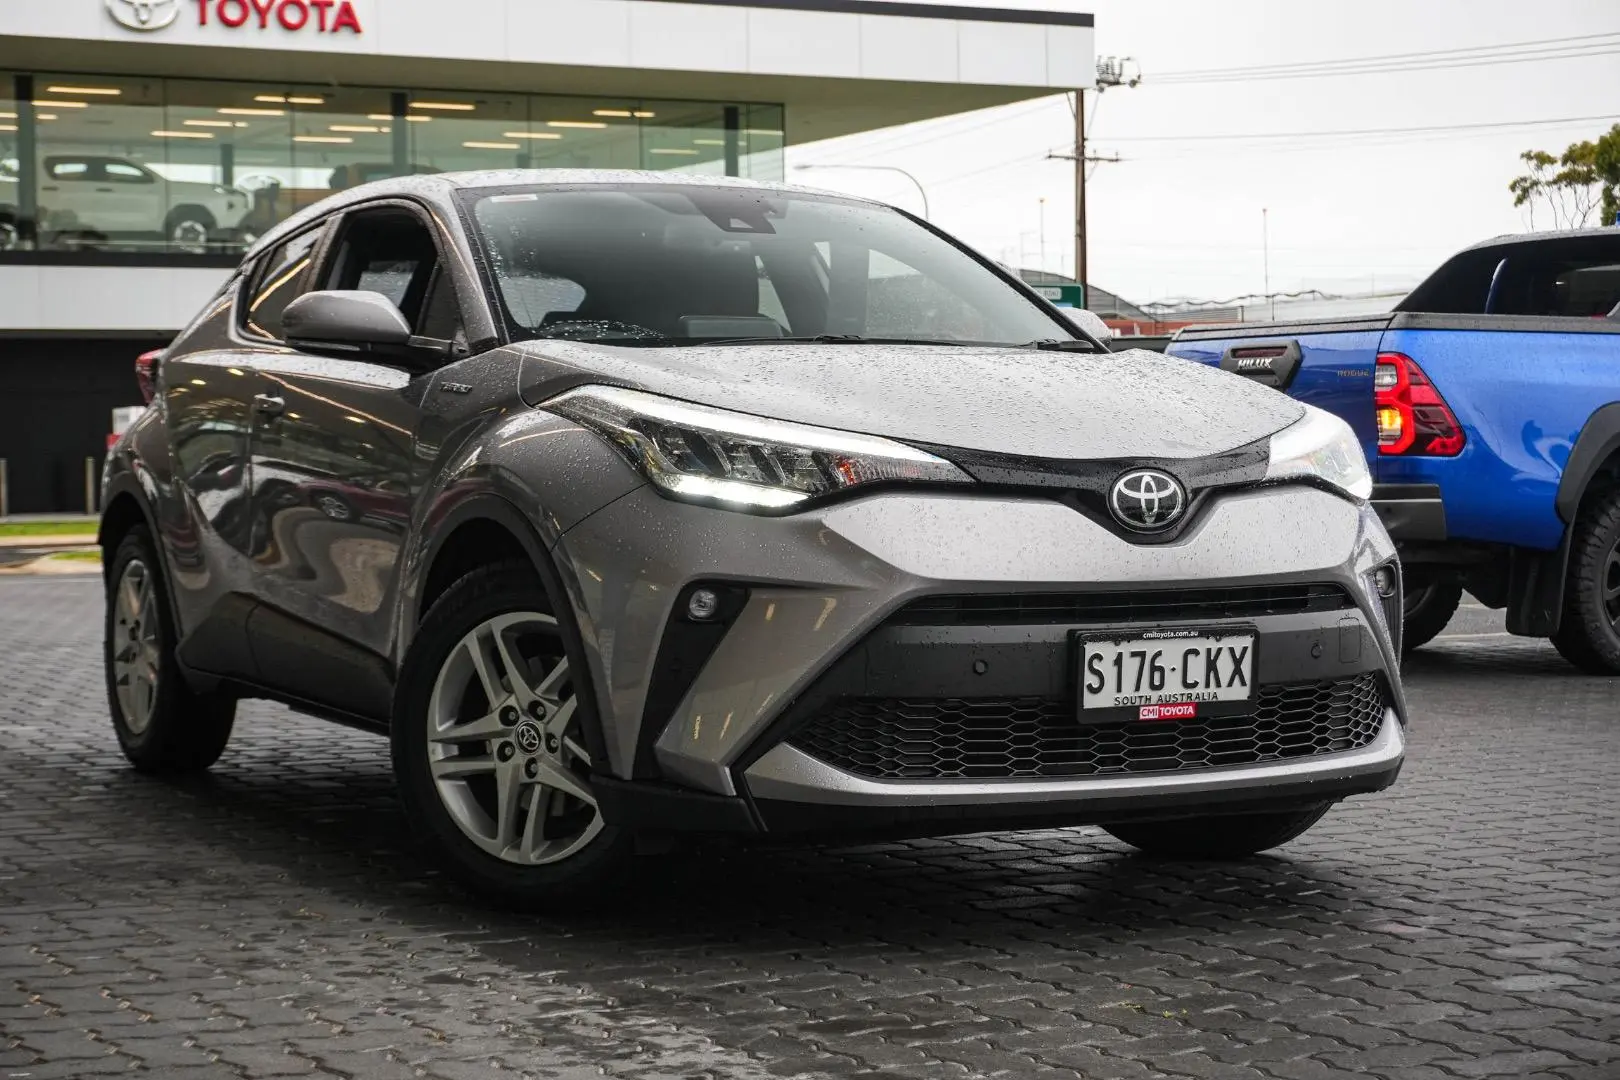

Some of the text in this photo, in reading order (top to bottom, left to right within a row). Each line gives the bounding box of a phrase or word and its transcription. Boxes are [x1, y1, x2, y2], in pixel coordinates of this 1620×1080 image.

[196, 0, 362, 33] TOYOTA
[1143, 630, 1199, 639] cmitoyota.com.au
[1114, 691, 1219, 706] SOUTH AUSTRALIA
[1141, 706, 1194, 717] CMI TOYOTA
